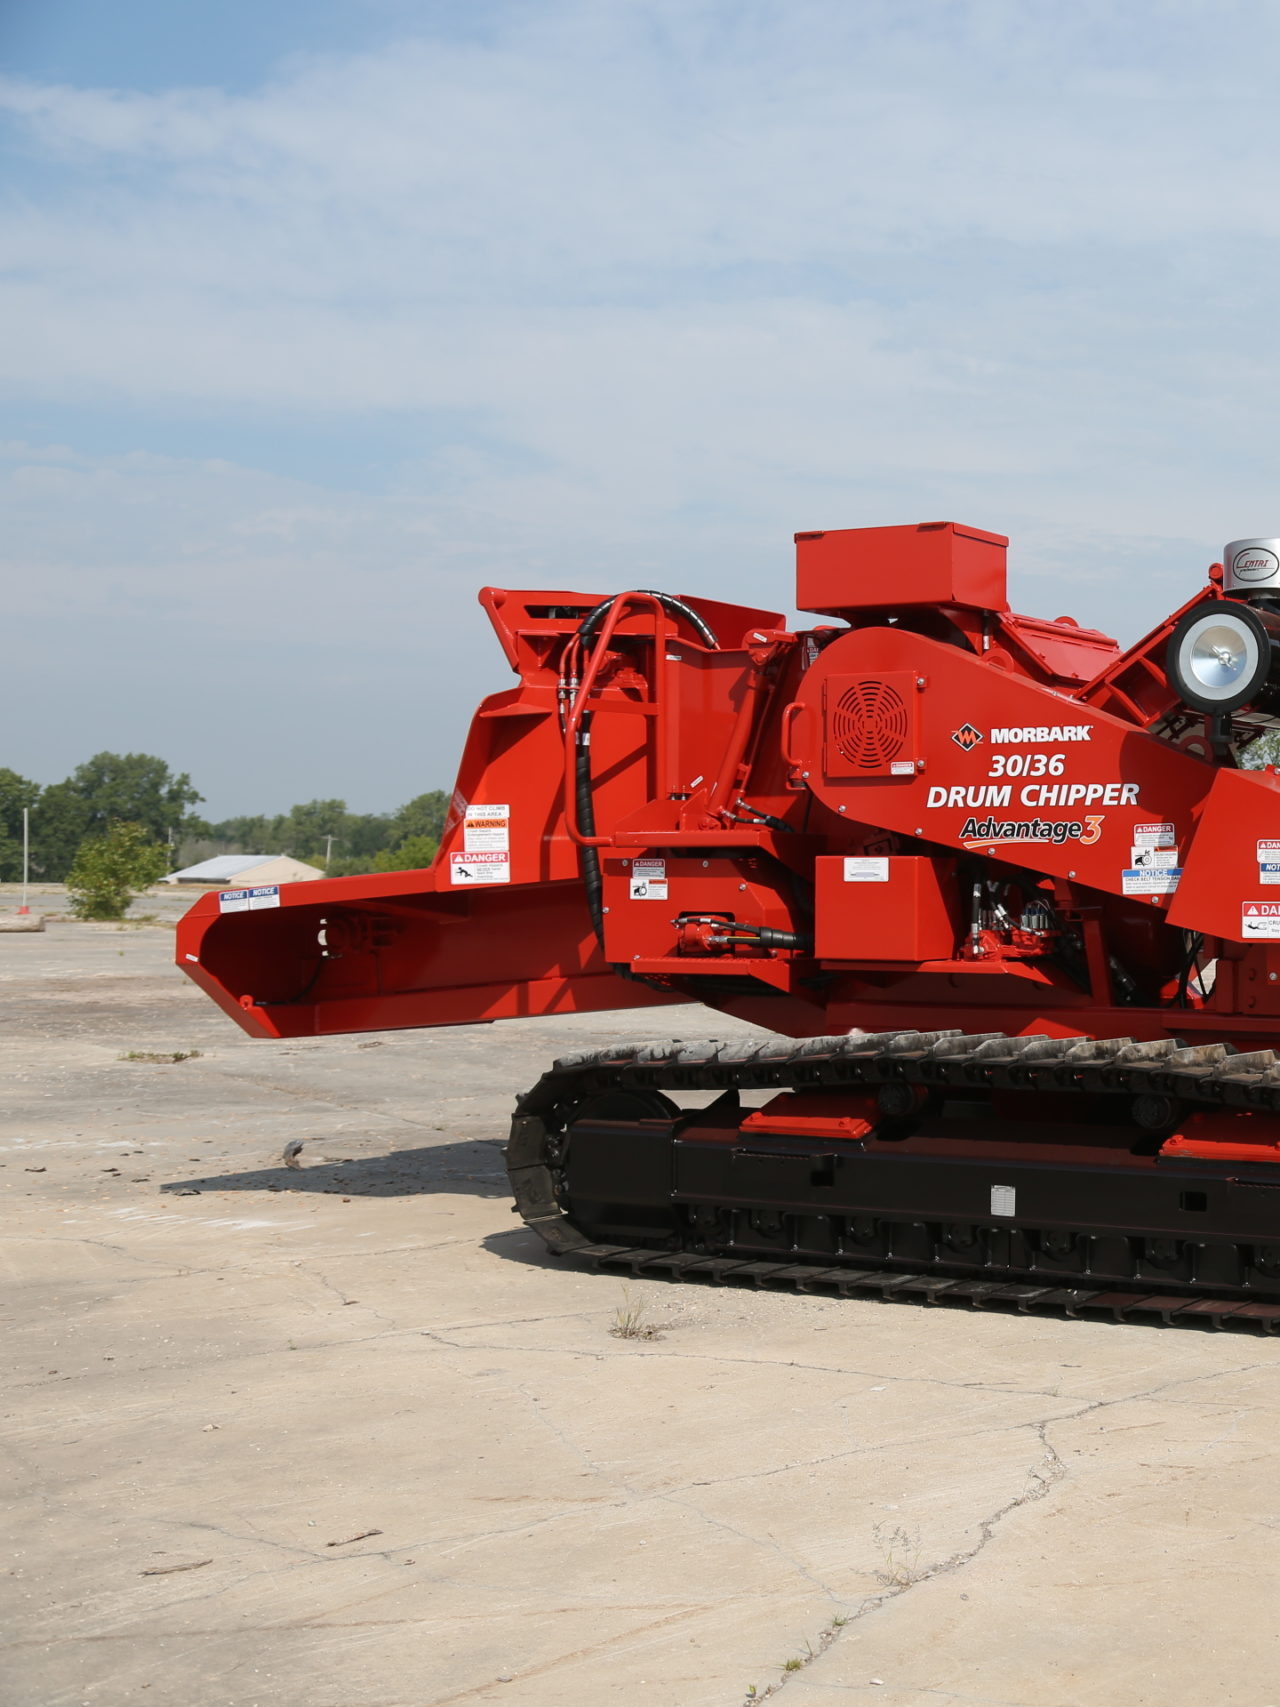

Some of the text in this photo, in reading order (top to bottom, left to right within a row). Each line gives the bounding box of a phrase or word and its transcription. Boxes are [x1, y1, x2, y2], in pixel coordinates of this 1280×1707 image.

[990, 726, 1091, 744] MORBARK
[988, 754, 1066, 777] 30/36
[927, 783, 1140, 808] DRUM CHIPPER
[475, 820, 506, 828] WARNING
[1142, 825, 1172, 833] DANGER
[464, 853, 506, 863] DANGER
[1140, 869, 1168, 877] NOTICE
[223, 891, 244, 900] NOTICE
[253, 887, 275, 896] NOTICE
